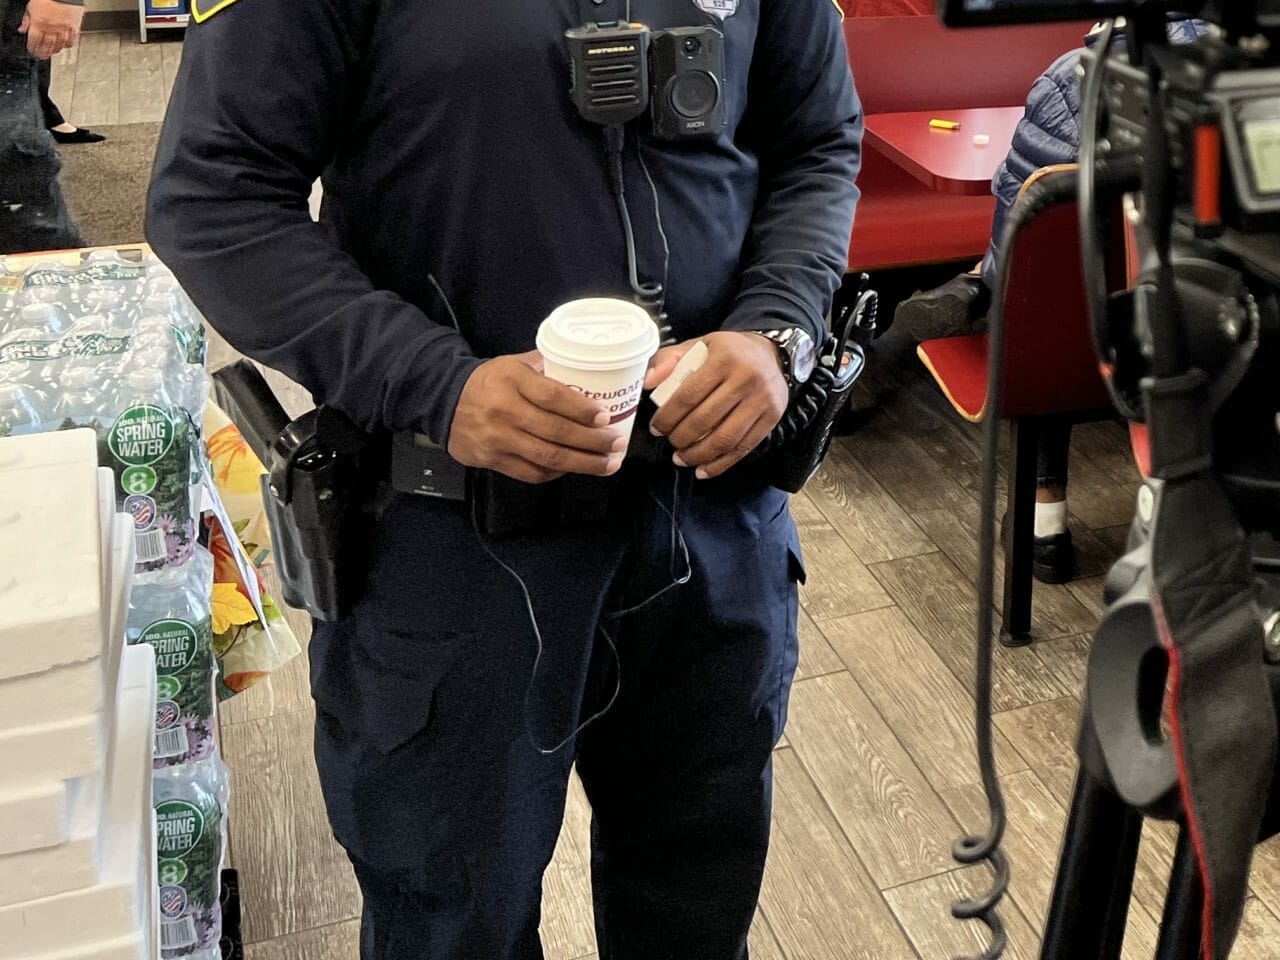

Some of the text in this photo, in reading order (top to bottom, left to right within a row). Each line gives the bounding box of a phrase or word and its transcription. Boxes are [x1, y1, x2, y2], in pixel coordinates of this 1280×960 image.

[588, 45, 635, 55] MOTOROLA
[117, 422, 166, 443] SPRING
[119, 439, 163, 457] WATER
[162, 629, 189, 638] NATURAL
[150, 636, 190, 655] PRING
[156, 651, 187, 668] ATER
[168, 809, 194, 819] NATURAL
[156, 817, 196, 836] PRING
